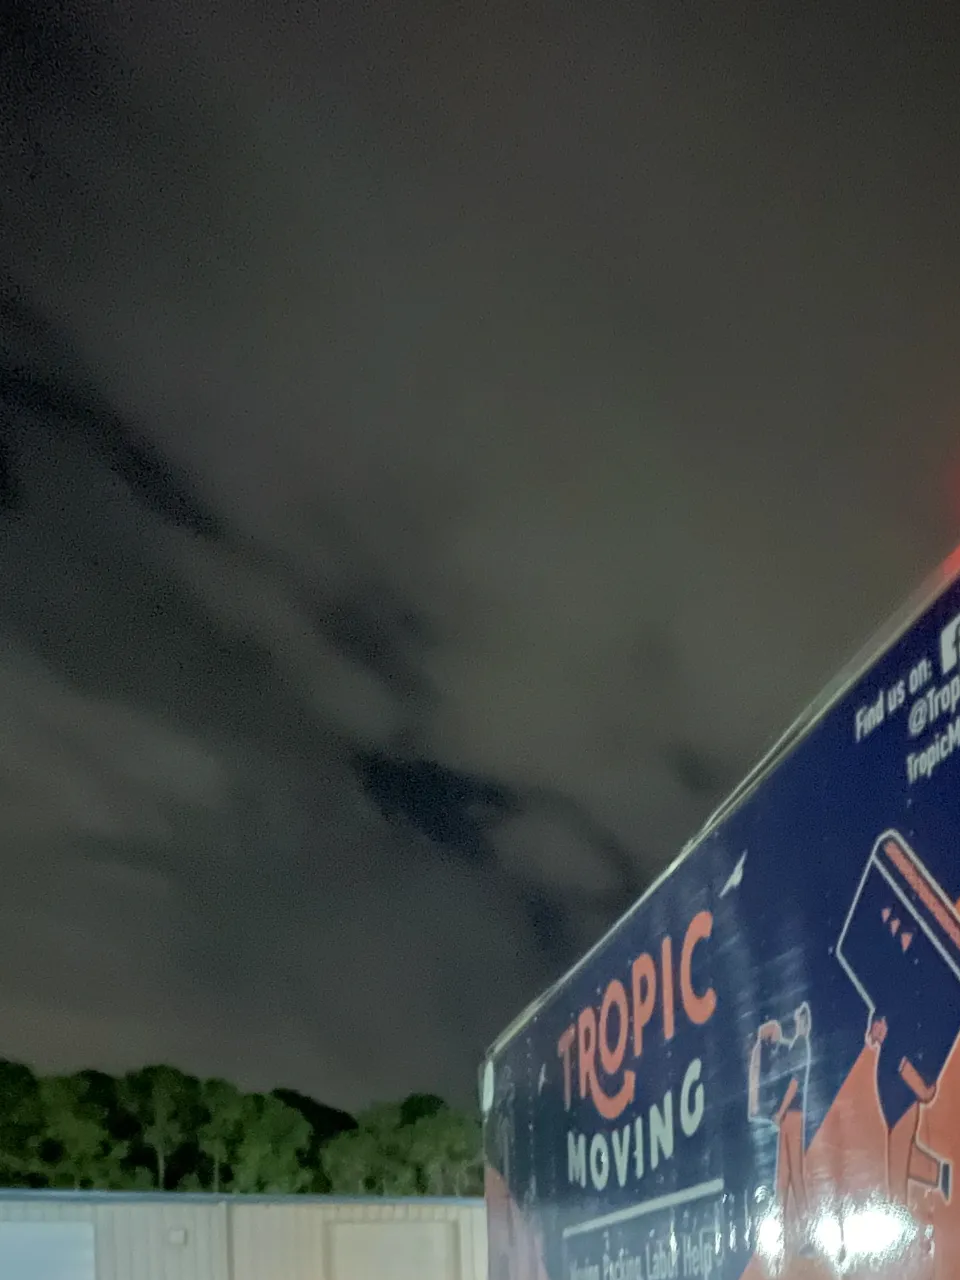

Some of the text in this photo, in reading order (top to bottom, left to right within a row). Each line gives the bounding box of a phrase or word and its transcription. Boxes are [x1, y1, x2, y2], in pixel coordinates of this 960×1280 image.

[855, 657, 932, 743] Find us on:
[557, 910, 718, 1119] TROPIC
[567, 1057, 705, 1191] MOVING
